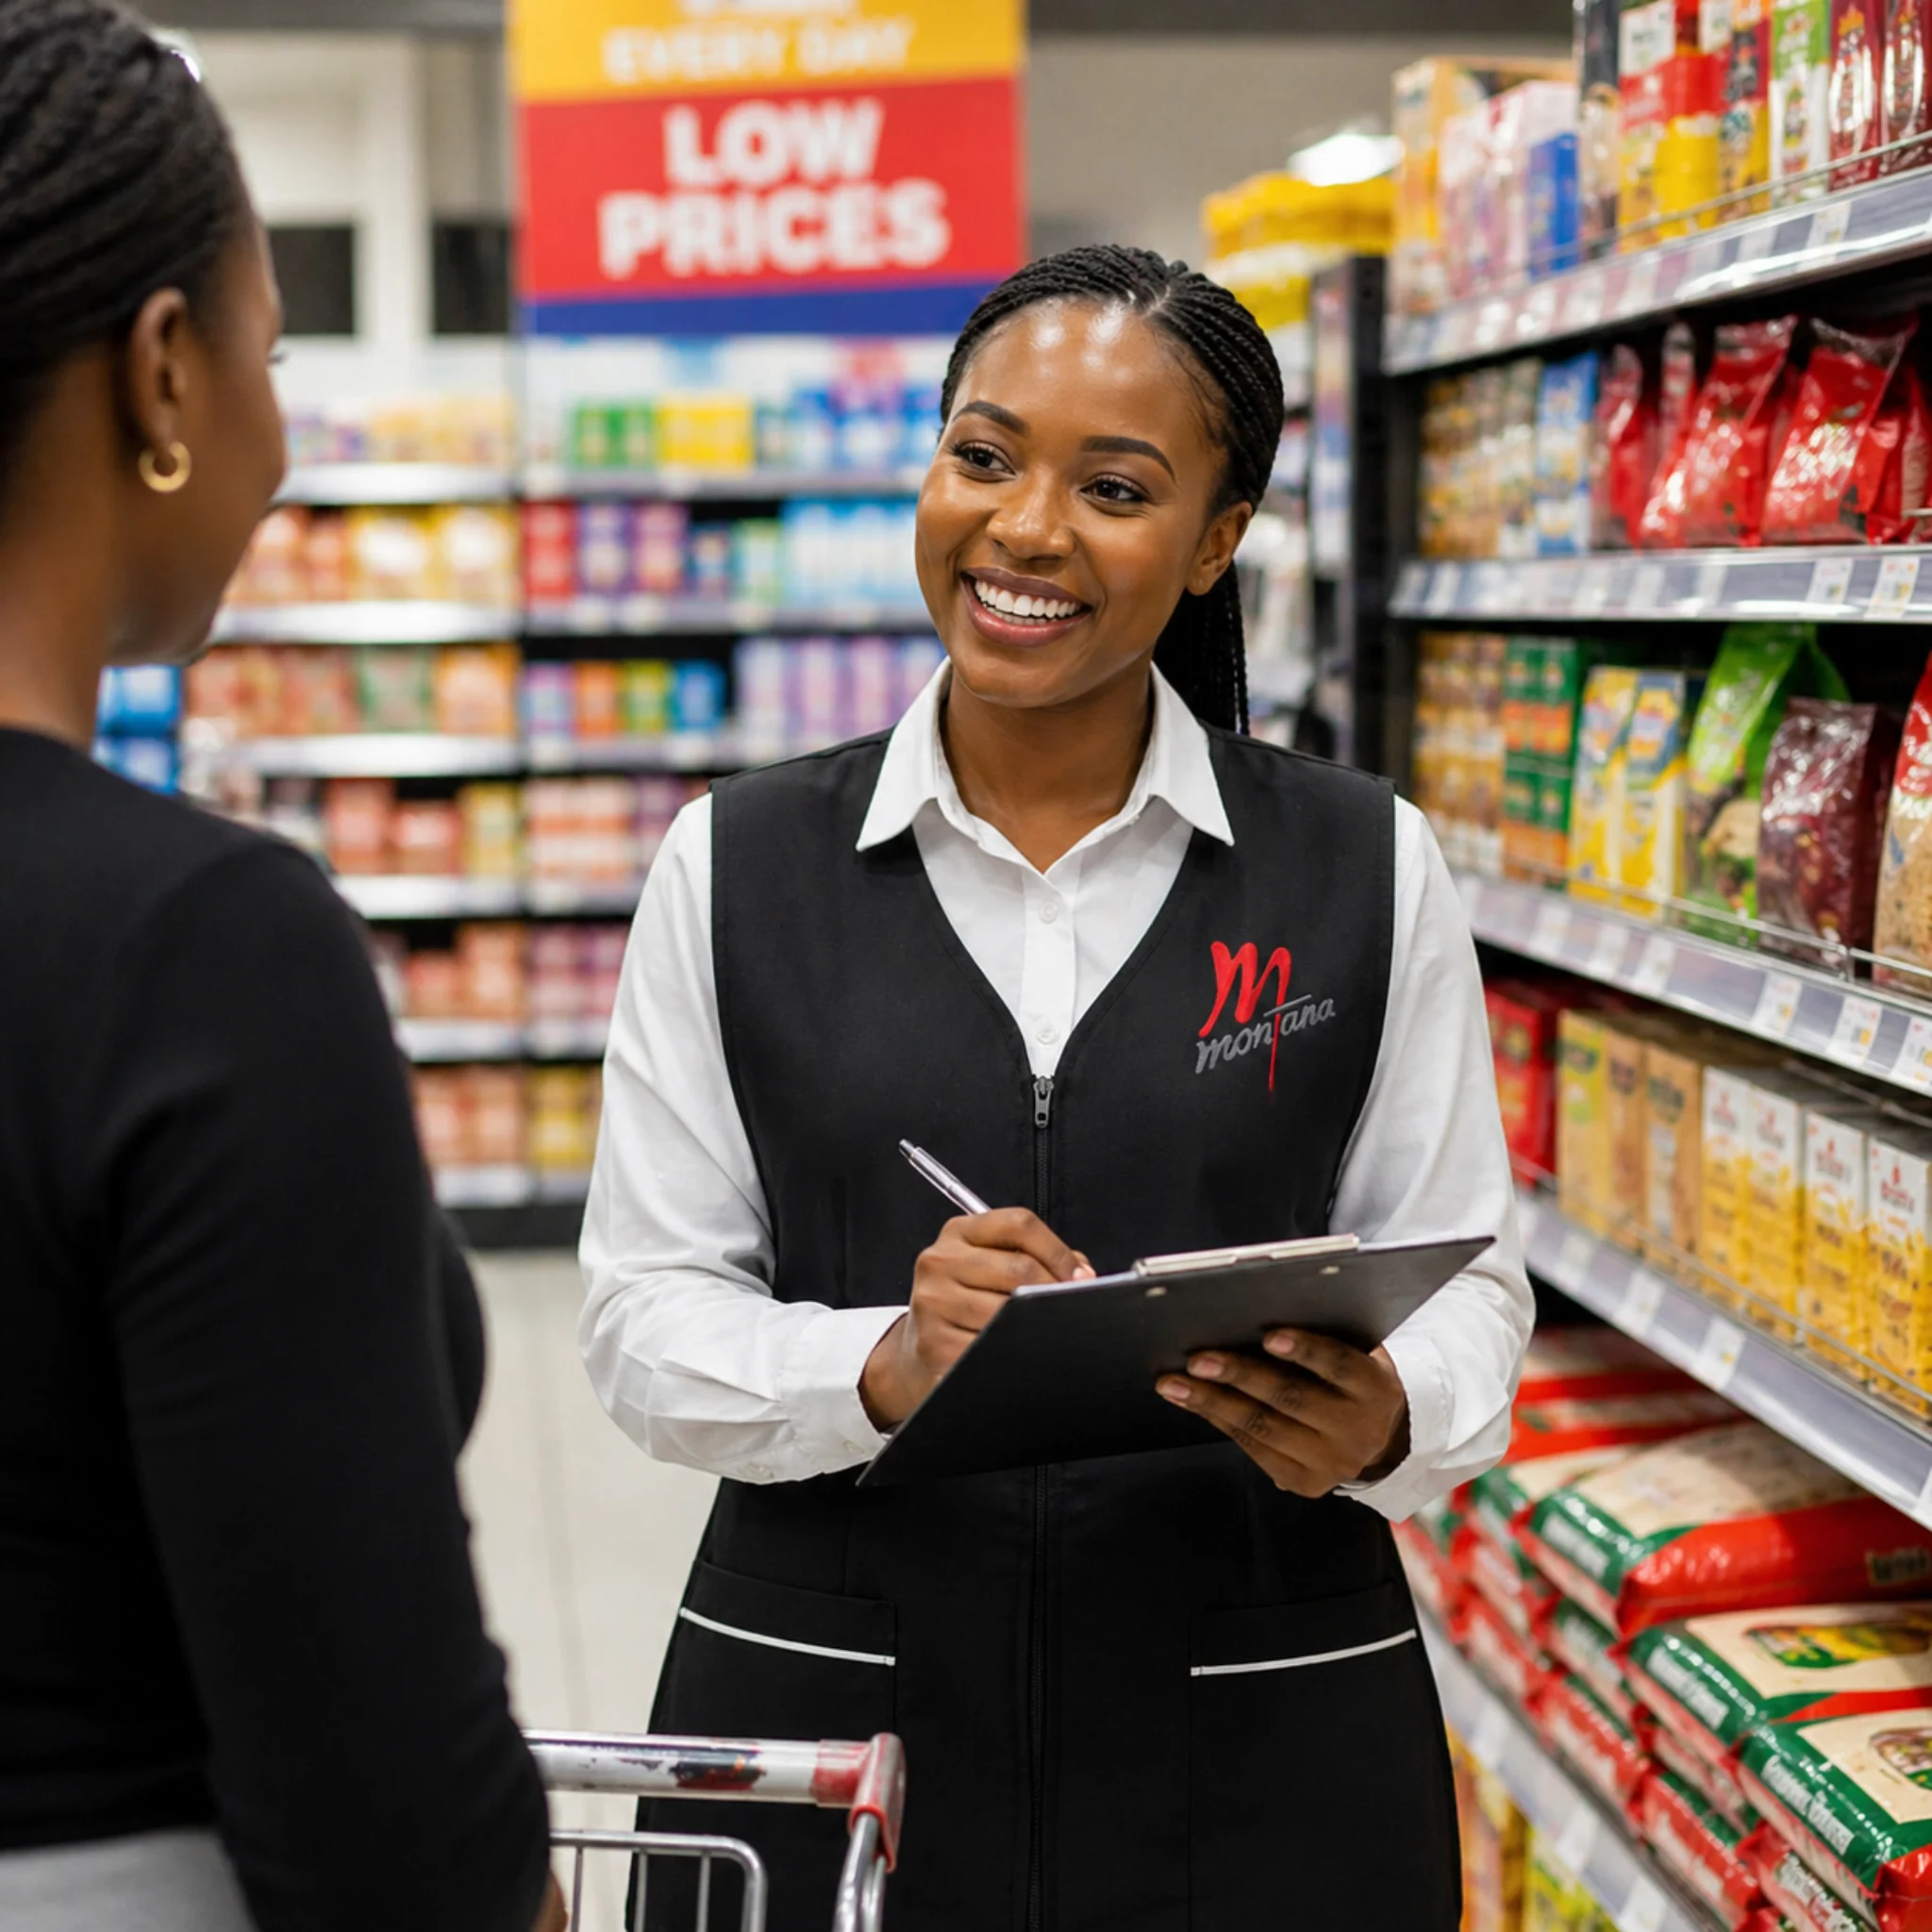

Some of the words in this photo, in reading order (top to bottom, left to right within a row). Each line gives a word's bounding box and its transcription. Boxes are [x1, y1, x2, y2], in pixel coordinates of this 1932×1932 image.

[602, 26, 787, 84] EVERY
[664, 98, 883, 188] LOW
[598, 180, 950, 278] PRICES
